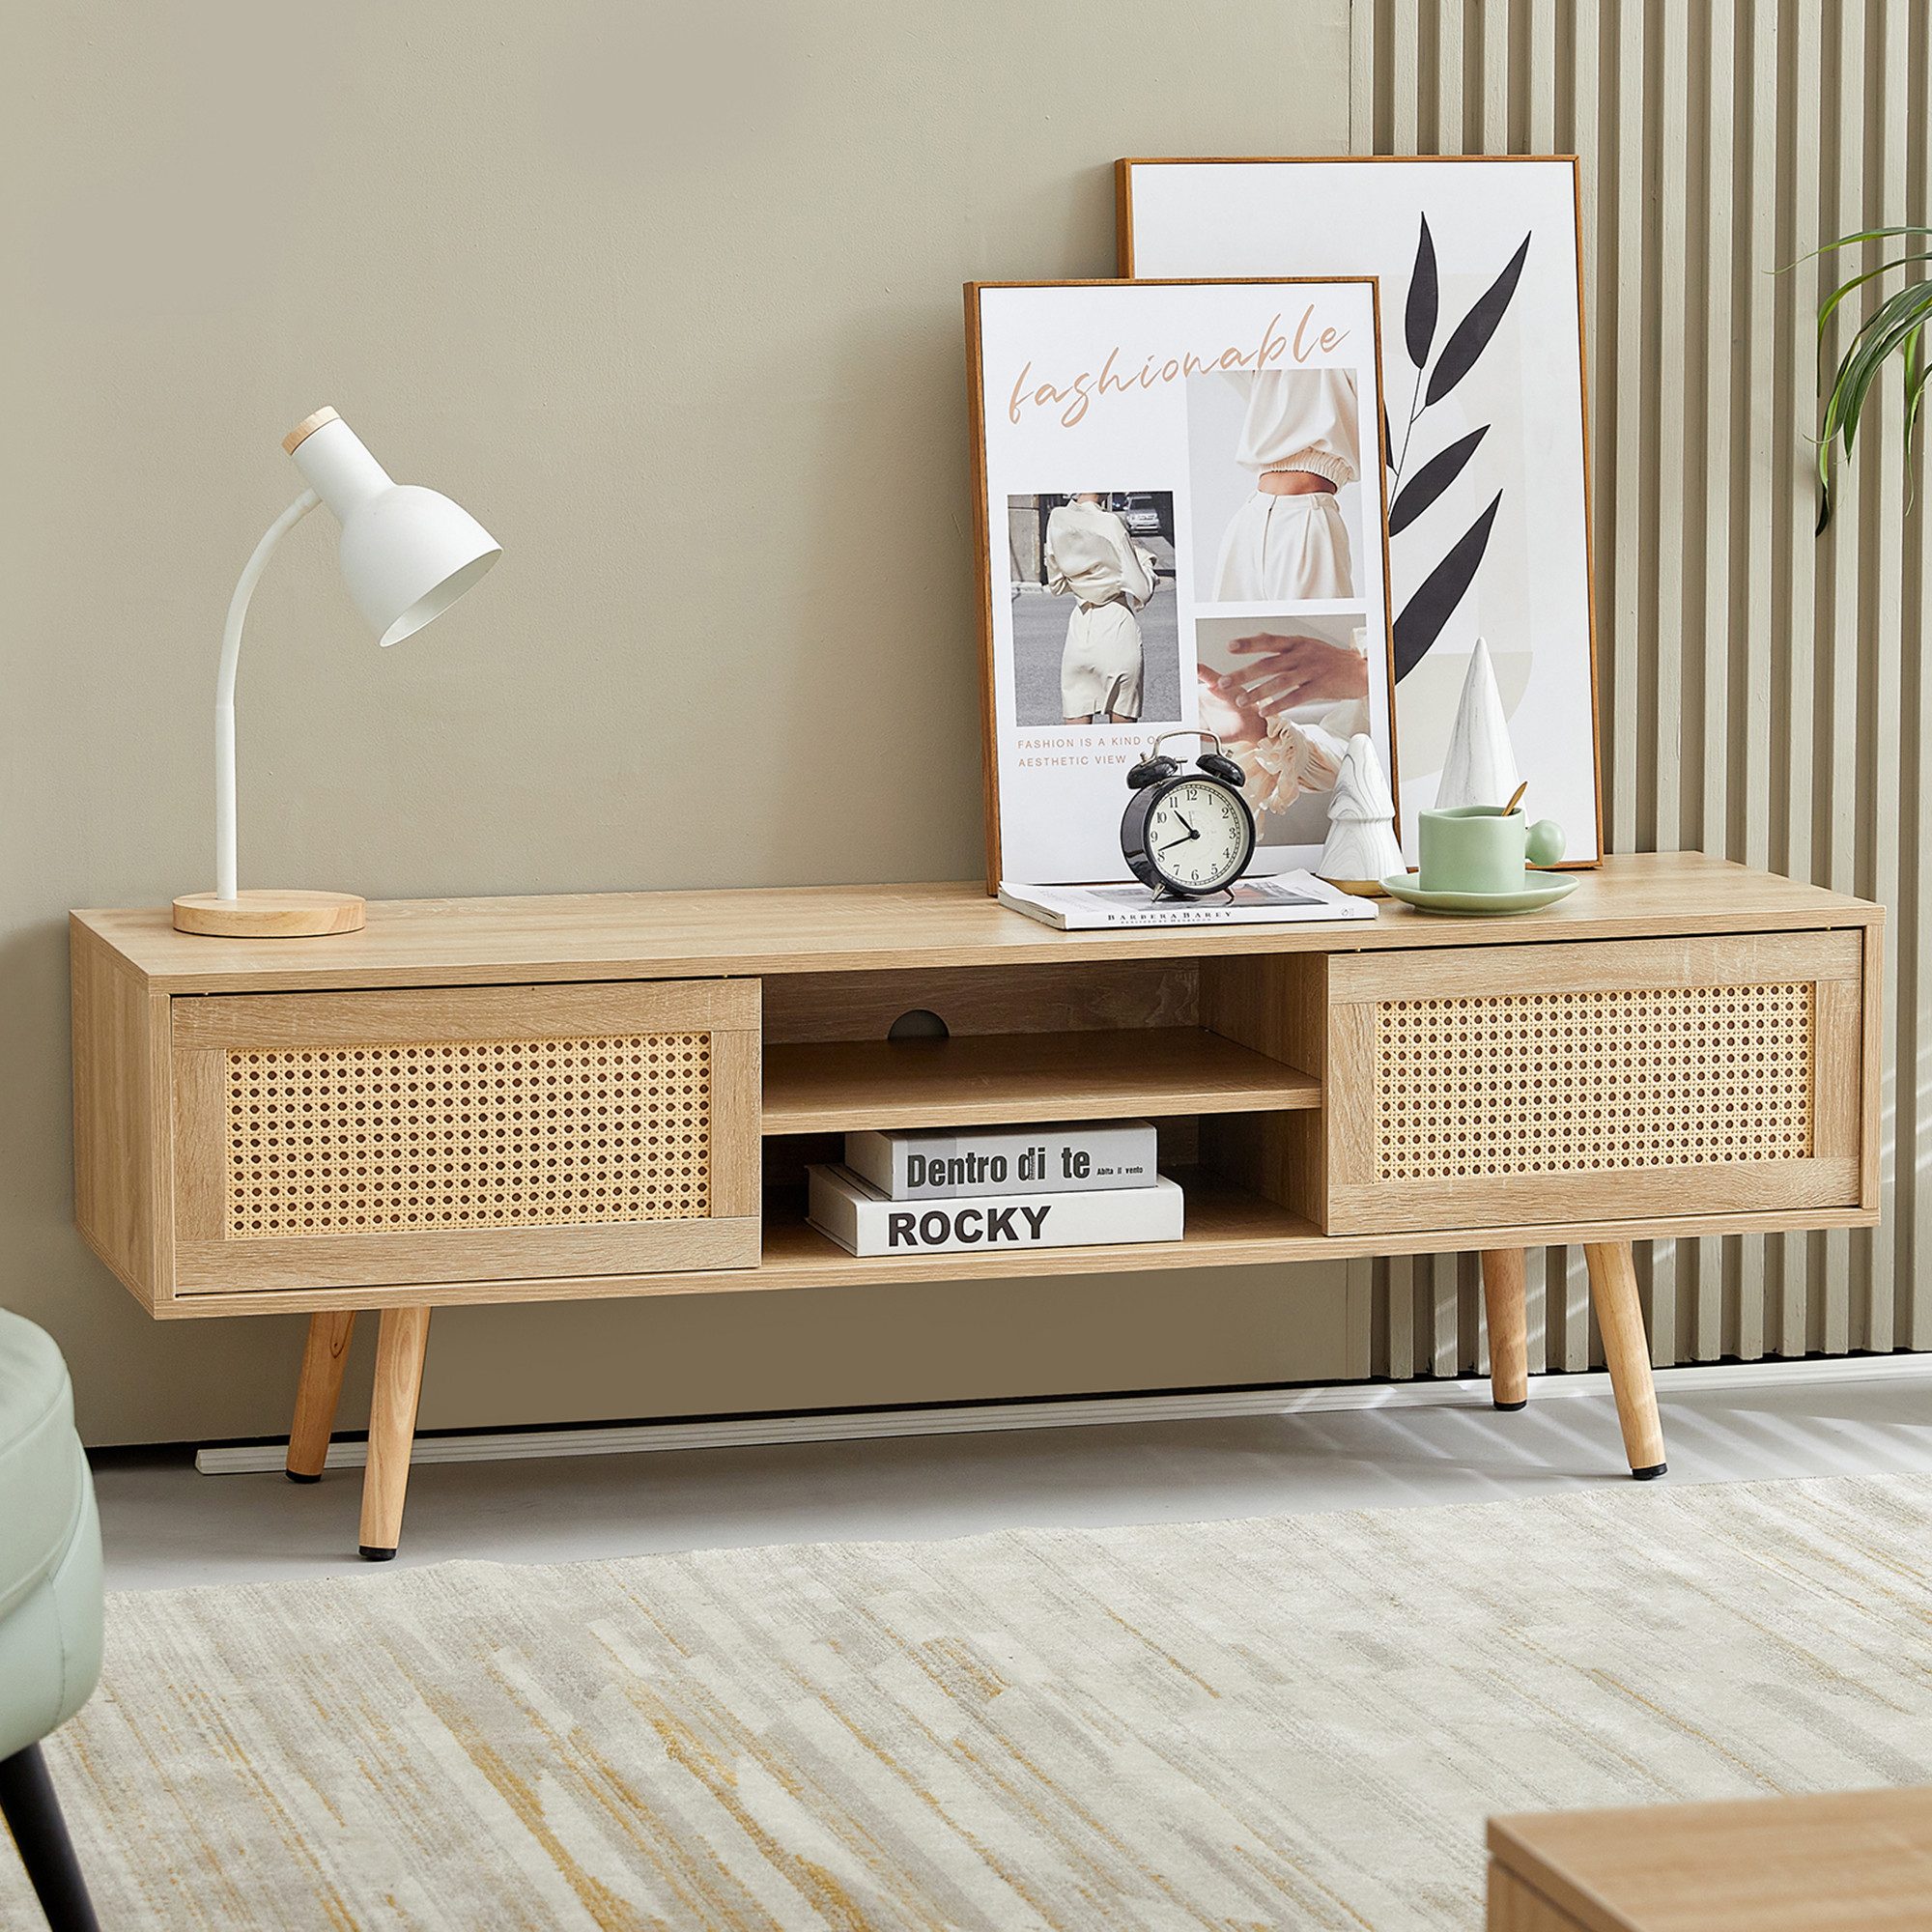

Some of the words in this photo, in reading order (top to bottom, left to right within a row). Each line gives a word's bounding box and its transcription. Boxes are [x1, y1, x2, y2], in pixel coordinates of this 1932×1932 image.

[1009, 303, 1350, 428] fashionable
[1017, 738, 1074, 750] FASHION
[1080, 738, 1092, 747] IS
[1097, 738, 1106, 747] A
[1111, 736, 1142, 746] KIND
[1018, 756, 1089, 767] AESTHETIC
[1094, 755, 1126, 764] VIEW
[1186, 789, 1198, 801] 12
[1208, 794, 1212, 805] 1
[1169, 797, 1179, 809] 11
[1156, 811, 1167, 823] 10
[1221, 808, 1229, 819] 2
[1150, 831, 1158, 842] 9
[1229, 828, 1236, 839] 3
[1157, 851, 1165, 863] 8
[1222, 847, 1230, 859] 4
[1173, 865, 1180, 876] 7
[1191, 869, 1199, 881] 6
[1210, 864, 1218, 875] 5
[907, 1151, 1008, 1188] Dentro
[1018, 1147, 1045, 1181] di
[1061, 1147, 1091, 1179] te
[888, 1205, 1052, 1247] ROCKY
